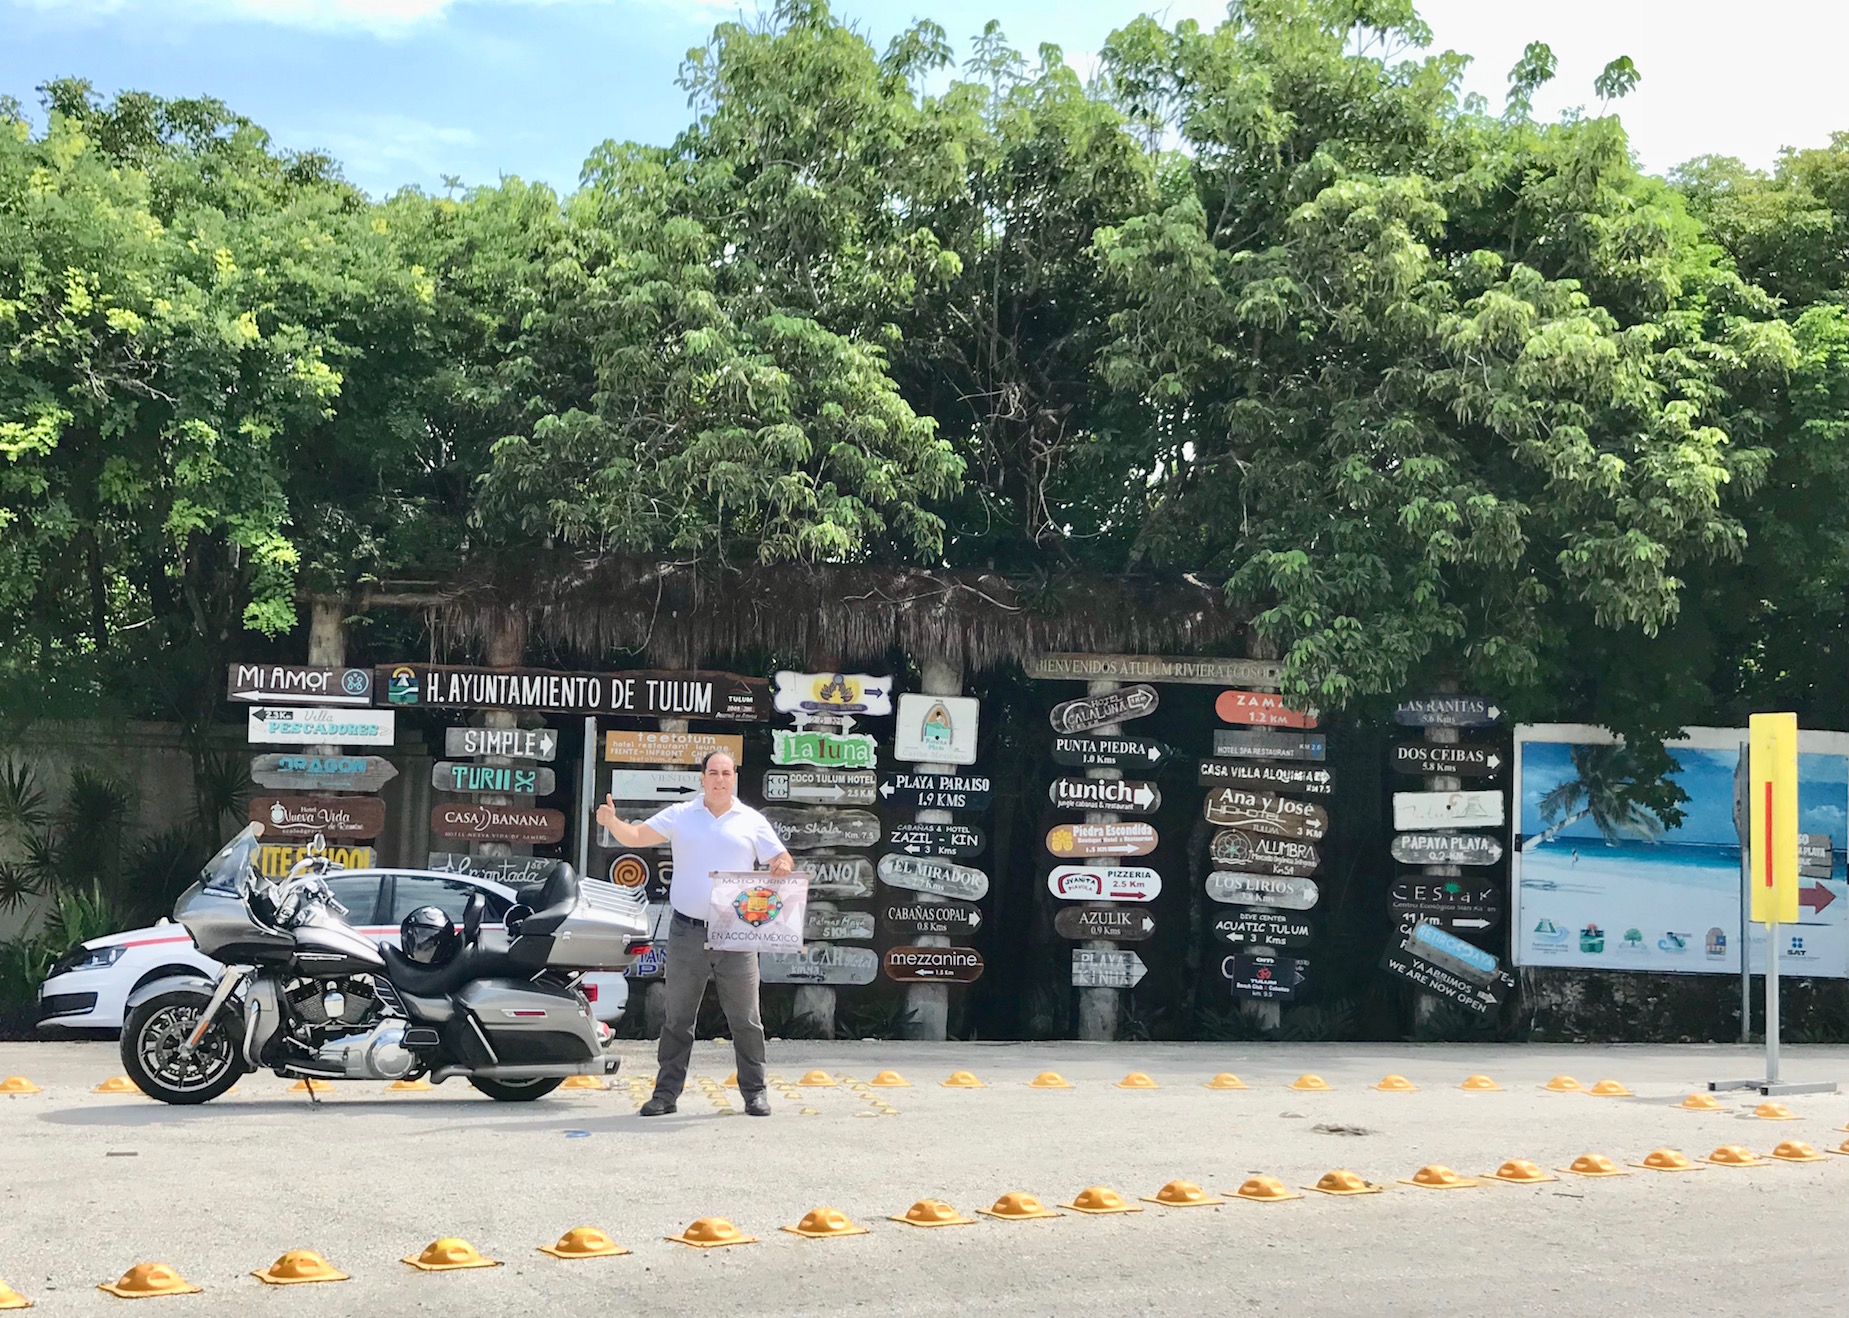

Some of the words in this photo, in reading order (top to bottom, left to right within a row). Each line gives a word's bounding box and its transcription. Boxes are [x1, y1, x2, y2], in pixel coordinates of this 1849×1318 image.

[1036, 659, 1117, 674] BIENVENIDOS
[1120, 662, 1129, 674] A
[1129, 662, 1172, 676] TULUM
[1175, 663, 1223, 678] RIVIERA
[426, 672, 444, 703] H.
[448, 674, 602, 708] AYUNTAMIENTO
[611, 679, 635, 710] DE
[646, 680, 712, 713] TULUM
[1091, 695, 1123, 708] HOTEL
[1398, 700, 1423, 712] LAS
[1427, 701, 1484, 712] RANITAS
[1068, 702, 1127, 725] CALALUNA
[1249, 712, 1266, 722] 1.2
[1270, 715, 1288, 724] KM
[1436, 715, 1456, 723] Kms
[268, 722, 380, 736] PESCADORES
[464, 730, 536, 755] SIMPLE
[637, 732, 716, 744] teetotum
[638, 742, 688, 750] restaurant
[788, 738, 814, 758] La
[818, 739, 869, 760] luna
[1056, 739, 1096, 752] PUNTA
[1100, 741, 1146, 755] PIEDRA
[1218, 746, 1238, 754] HOTEL
[1240, 746, 1252, 755] SPA
[1253, 748, 1294, 756] RESTAURANT
[1083, 754, 1095, 763] 1.0
[1097, 755, 1116, 764] Kms
[1398, 748, 1427, 759] DOS
[1430, 748, 1484, 762] CEIBAS
[1200, 764, 1228, 776] CASA
[1230, 766, 1261, 778] VILLA
[1422, 762, 1435, 771] 5.8
[1437, 763, 1456, 772] Kms
[790, 774, 814, 782] COCO
[816, 774, 846, 783] TULUM
[847, 775, 875, 784] HOTEL
[896, 775, 934, 789] PLAYA
[939, 777, 990, 791] PARAISO
[1059, 778, 1132, 802] tunich
[918, 792, 934, 806] 1.9
[937, 794, 966, 807] KMS
[1105, 802, 1134, 810] restaurant
[1220, 788, 1256, 806] Ana
[1262, 797, 1272, 811] y
[1277, 798, 1314, 816] José
[318, 808, 350, 823] Vida
[444, 812, 479, 823] CASA
[492, 813, 548, 826] BANANA
[774, 821, 800, 841] Yoga
[803, 822, 842, 834] Shala
[1073, 825, 1104, 837] Piedra
[1106, 824, 1152, 836] Escondida
[1297, 827, 1303, 836] 3
[1306, 829, 1323, 838] KM
[890, 832, 933, 844] ZAZIL
[952, 834, 978, 846] KIN
[1402, 836, 1447, 850] PAPAYA
[1450, 837, 1488, 850] PLAYA
[925, 846, 930, 854] 3
[938, 847, 956, 855] Kms
[1256, 839, 1315, 860] ALUMBRA
[895, 860, 912, 873] EL
[916, 862, 980, 886] MIRADOR
[1108, 870, 1151, 878] PIZZERIA
[926, 880, 944, 892] Kms
[1215, 876, 1242, 889] LOS
[1246, 878, 1294, 893] LIRIOS
[1255, 893, 1275, 903] Kms
[888, 905, 934, 920] CABAÑAS
[936, 908, 967, 921] COPAL
[1079, 912, 1132, 925] AZULIK
[1259, 914, 1286, 922] CENTER
[1402, 913, 1416, 923] 11
[917, 923, 928, 931] 0.8
[930, 923, 947, 932] Kms
[1091, 927, 1102, 935] 0.9
[1104, 927, 1121, 935] Kms
[1215, 921, 1265, 932] ACUATIC
[1269, 924, 1309, 936] TULUM
[711, 932, 723, 940] EN
[725, 930, 761, 941] ACCIÓN
[763, 931, 798, 942] MÉXICO
[1250, 934, 1257, 943] 3
[1266, 936, 1287, 945] Kms
[1418, 926, 1457, 951] RETIRO
[890, 952, 977, 966] mezzanine
[1081, 954, 1125, 968] PLAYA
[1412, 959, 1426, 971] YA
[1426, 965, 1473, 994] ABRIMOS
[1389, 959, 1404, 973] WE
[1406, 969, 1428, 984] ARE
[1429, 980, 1456, 997] NOW
[1457, 994, 1487, 1013] OPEN
